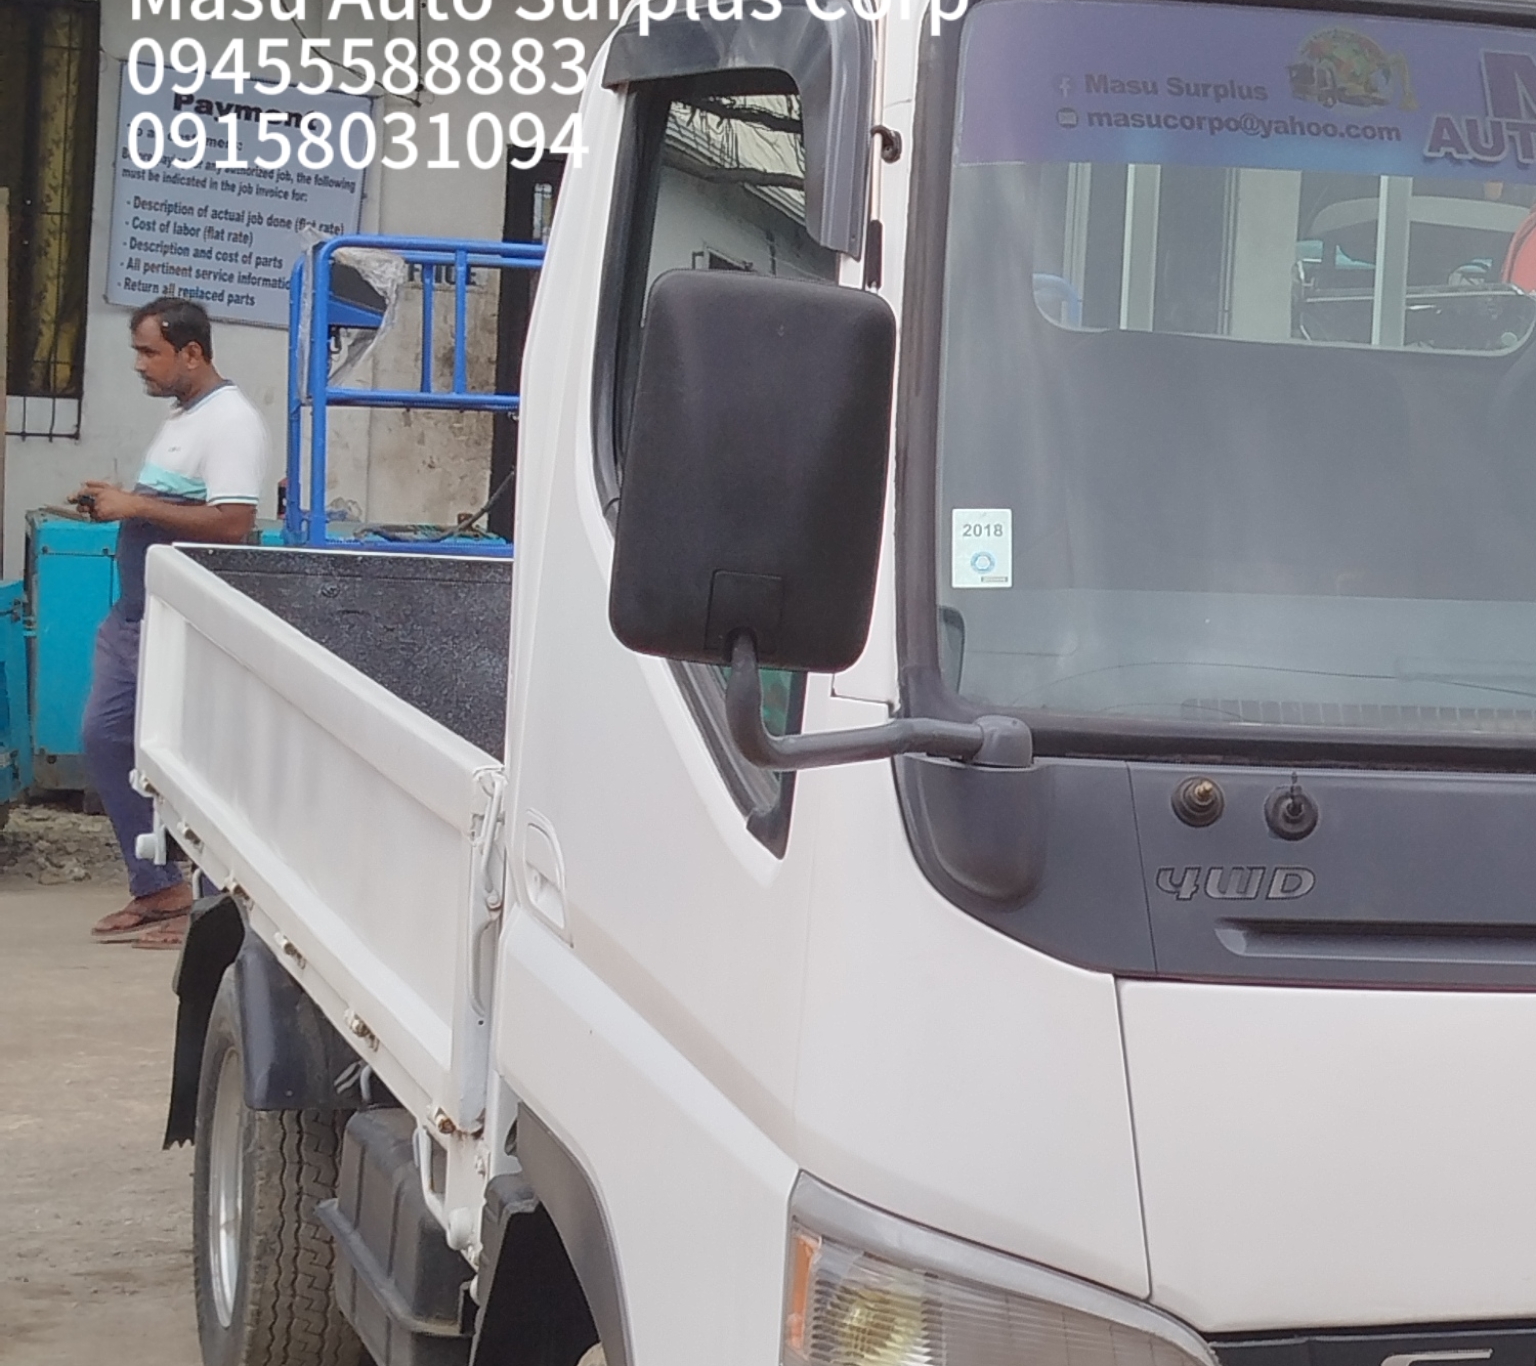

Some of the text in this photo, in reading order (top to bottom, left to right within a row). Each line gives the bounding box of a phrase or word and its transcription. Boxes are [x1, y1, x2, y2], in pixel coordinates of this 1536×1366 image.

[1084, 73, 1269, 103] Masu Surplus
[1087, 108, 1402, 141] masucorpo@yahoo.com
[122, 167, 146, 181] must
[148, 169, 160, 183] be
[162, 172, 208, 189] indicated
[209, 177, 218, 190] in
[221, 179, 236, 192] the
[238, 181, 254, 197] job
[255, 184, 289, 201] invoice
[297, 172, 312, 184] the
[314, 174, 356, 194] following
[132, 216, 157, 232] Cost
[159, 220, 171, 234] of
[173, 222, 201, 238] labor
[133, 195, 195, 216] Description
[197, 205, 209, 218] of
[211, 208, 245, 223] actual
[246, 211, 264, 227] job
[266, 214, 293, 230] done
[129, 236, 284, 270] Description and cost of parts
[126, 256, 291, 291] All pertinent service informatio
[123, 276, 256, 307] Return all replaced parts
[963, 523, 1004, 538] 2018
[1156, 865, 1317, 902] 4WD
